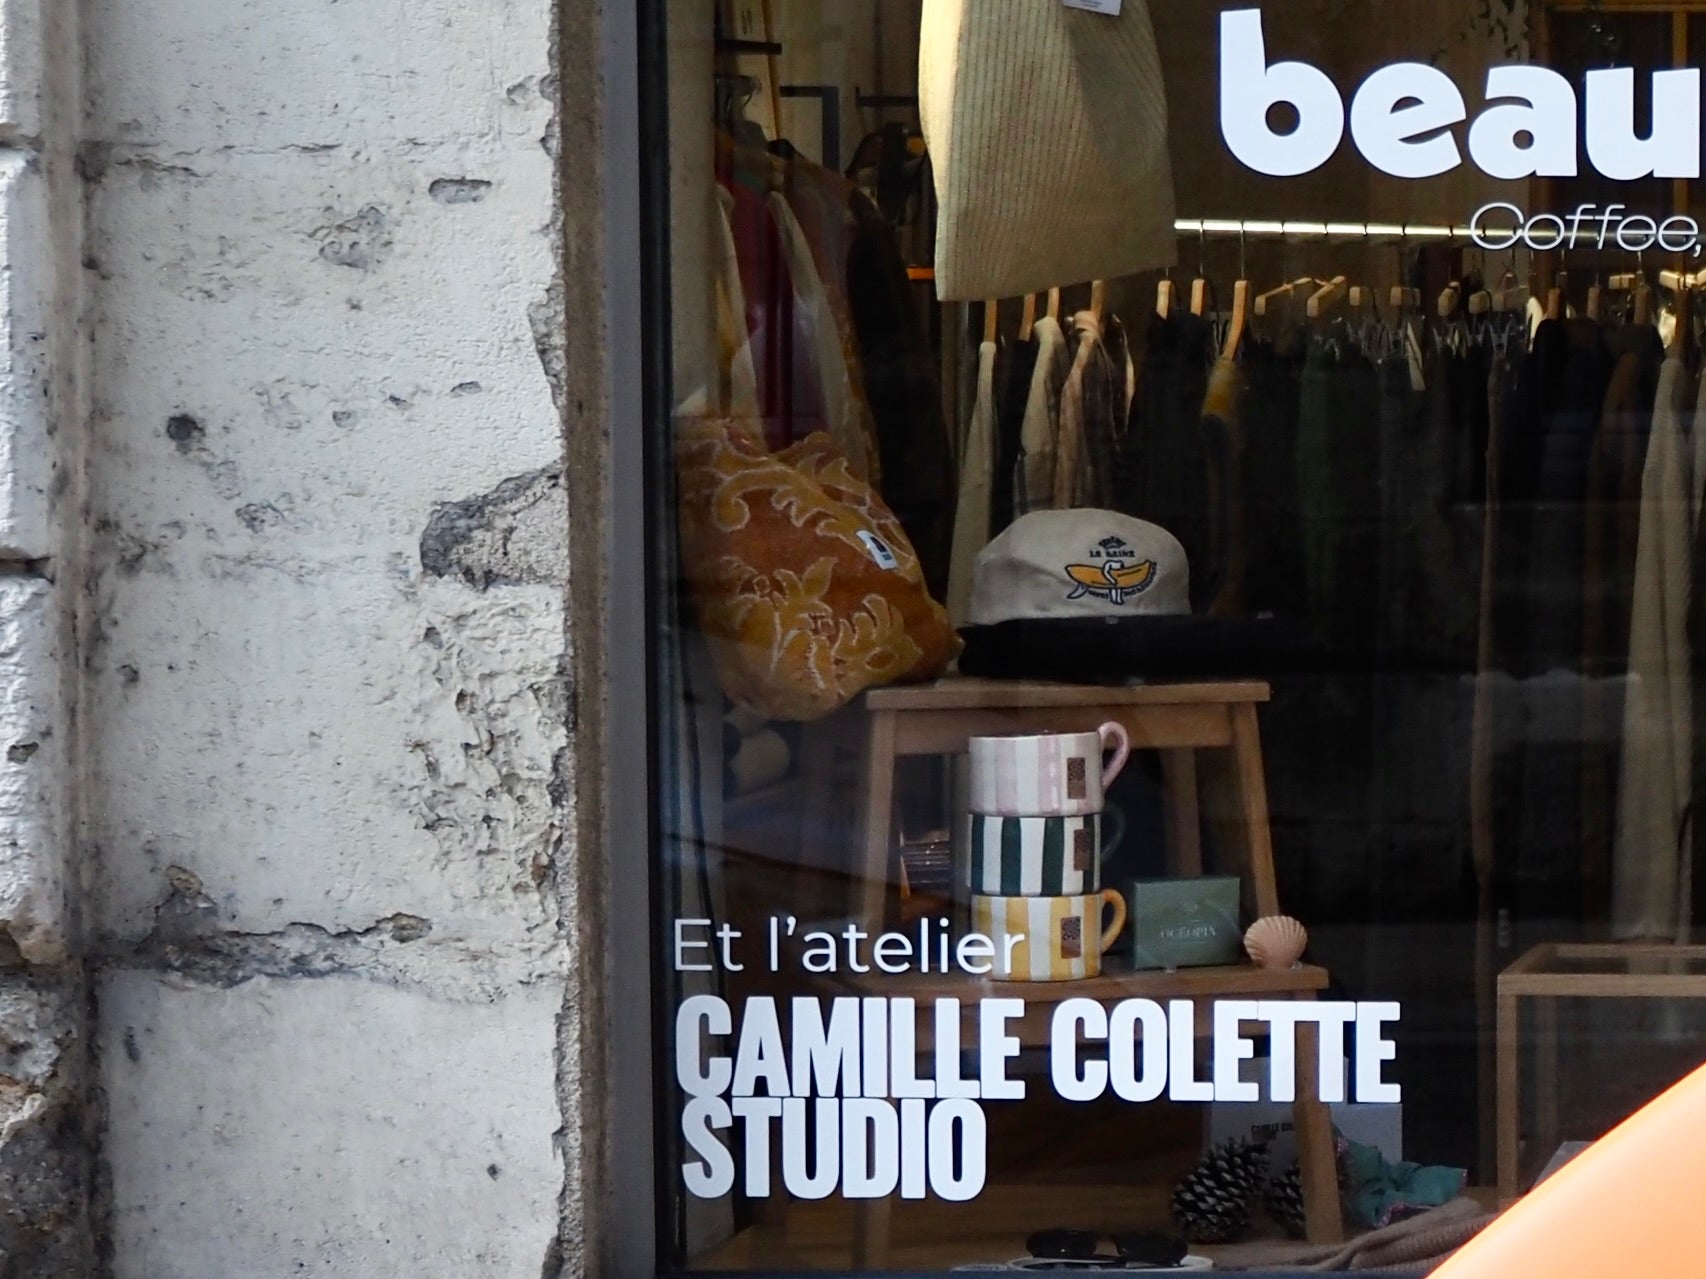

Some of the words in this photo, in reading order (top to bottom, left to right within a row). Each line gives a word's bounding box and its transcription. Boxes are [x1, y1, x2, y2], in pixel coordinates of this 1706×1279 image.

[1470, 202, 1701, 257] Coffee,
[674, 919, 744, 972] Et
[675, 995, 1026, 1100] CAMILLE
[1051, 997, 1401, 1103] COLETTE
[681, 1097, 987, 1201] STUDIO
